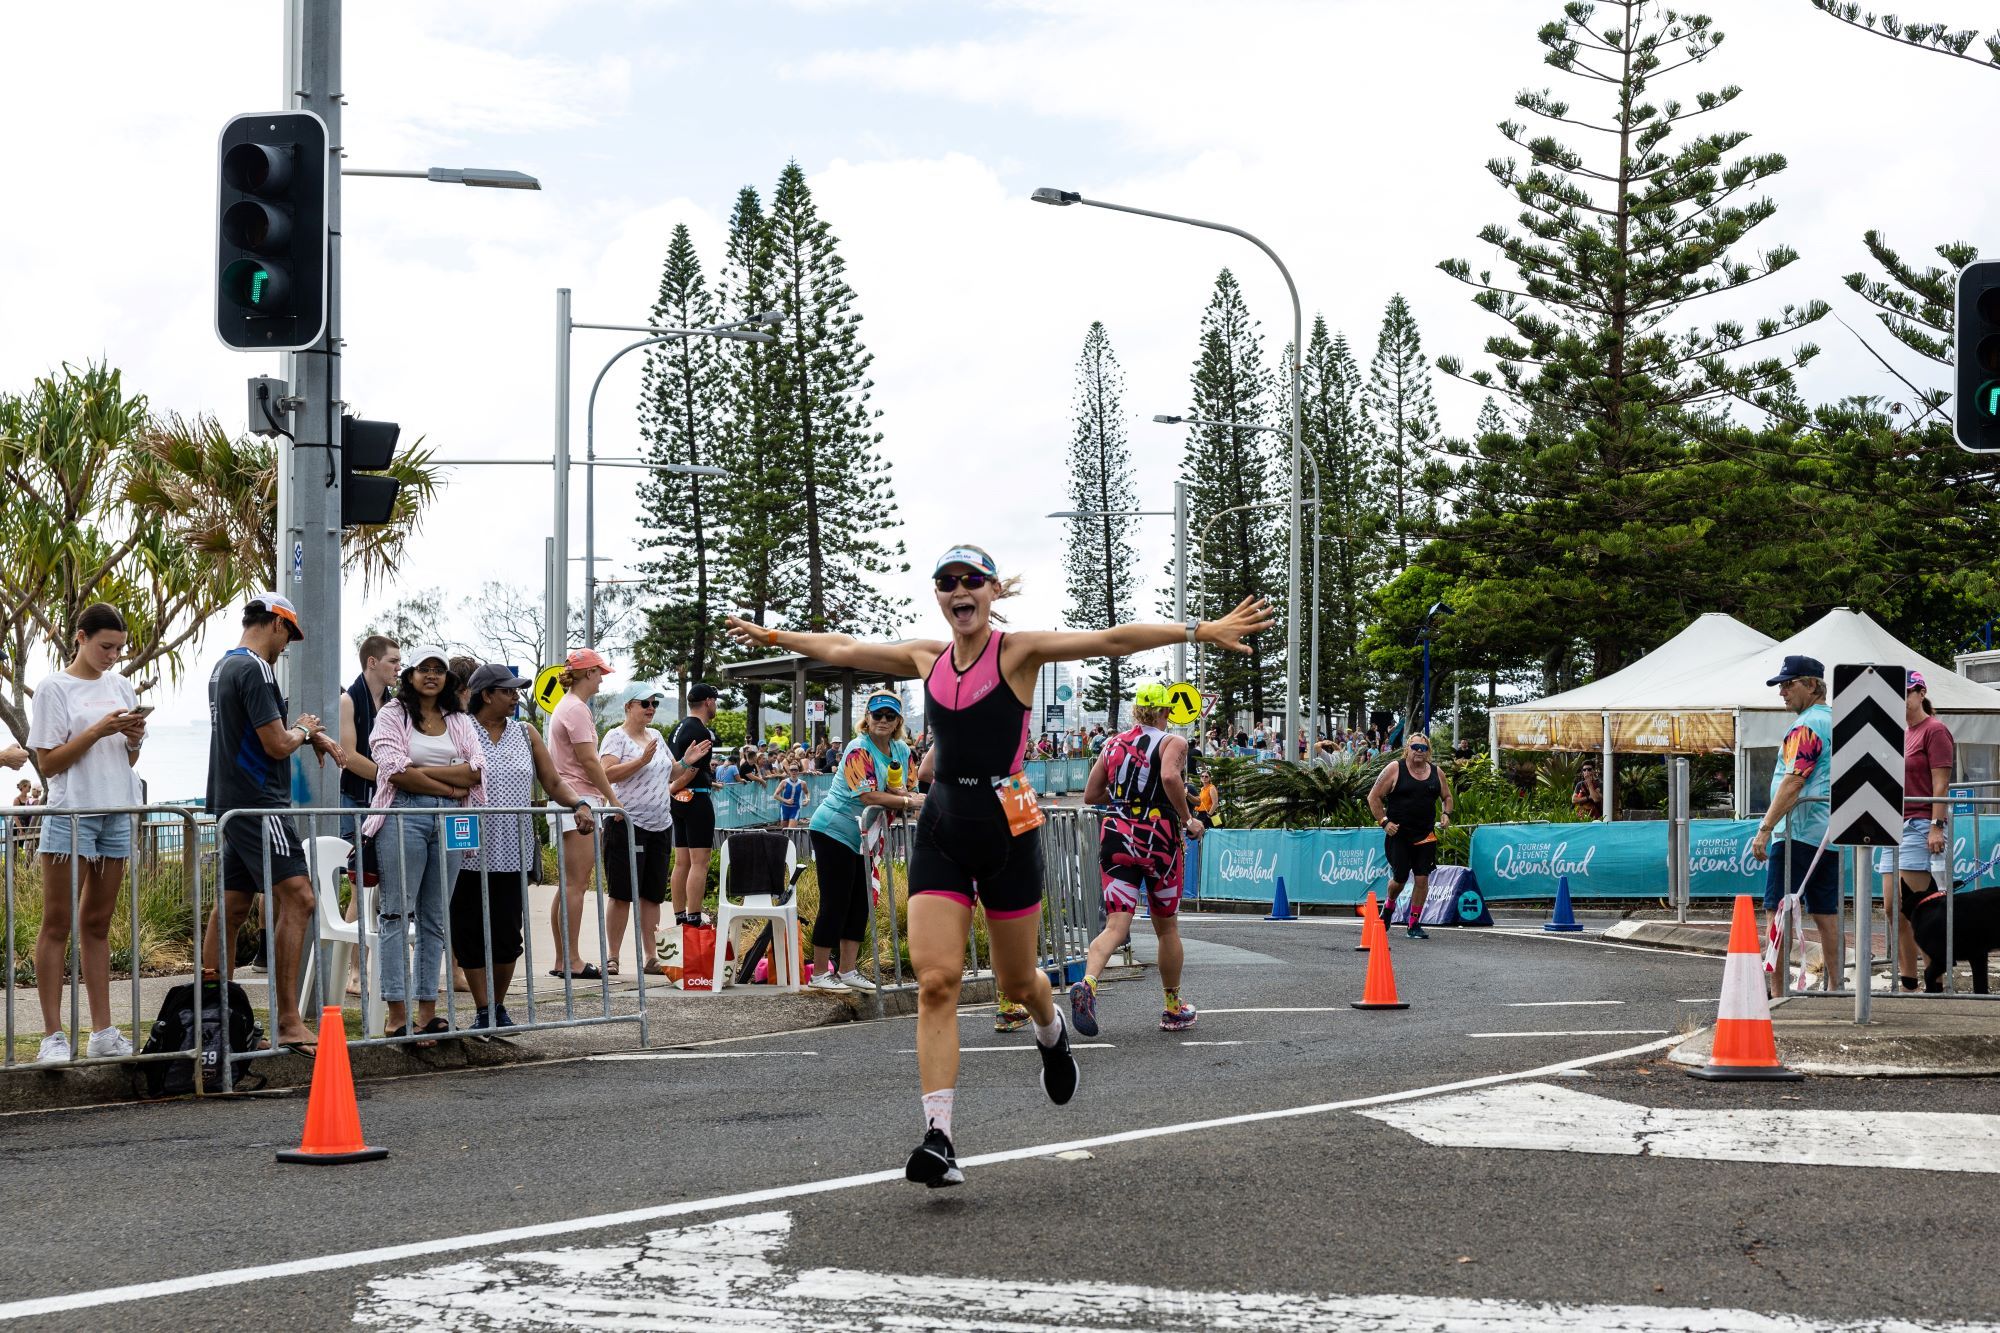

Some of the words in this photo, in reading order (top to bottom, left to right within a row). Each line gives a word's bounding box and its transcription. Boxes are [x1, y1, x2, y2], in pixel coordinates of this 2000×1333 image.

[455, 822, 469, 832] ATF
[1517, 843, 1551, 851] TOURISM
[1697, 838, 1738, 847] TOURISM
[1339, 850, 1364, 858] TOURISM
[1517, 852, 1521, 860] &
[1522, 851, 1549, 860] EVENTS
[1695, 848, 1701, 856] &
[1703, 847, 1737, 855] EVENTS
[1343, 857, 1364, 866] EVENTS
[1494, 841, 1596, 880] Queensland
[1220, 849, 1278, 883] Queensland
[687, 977, 714, 986] coles
